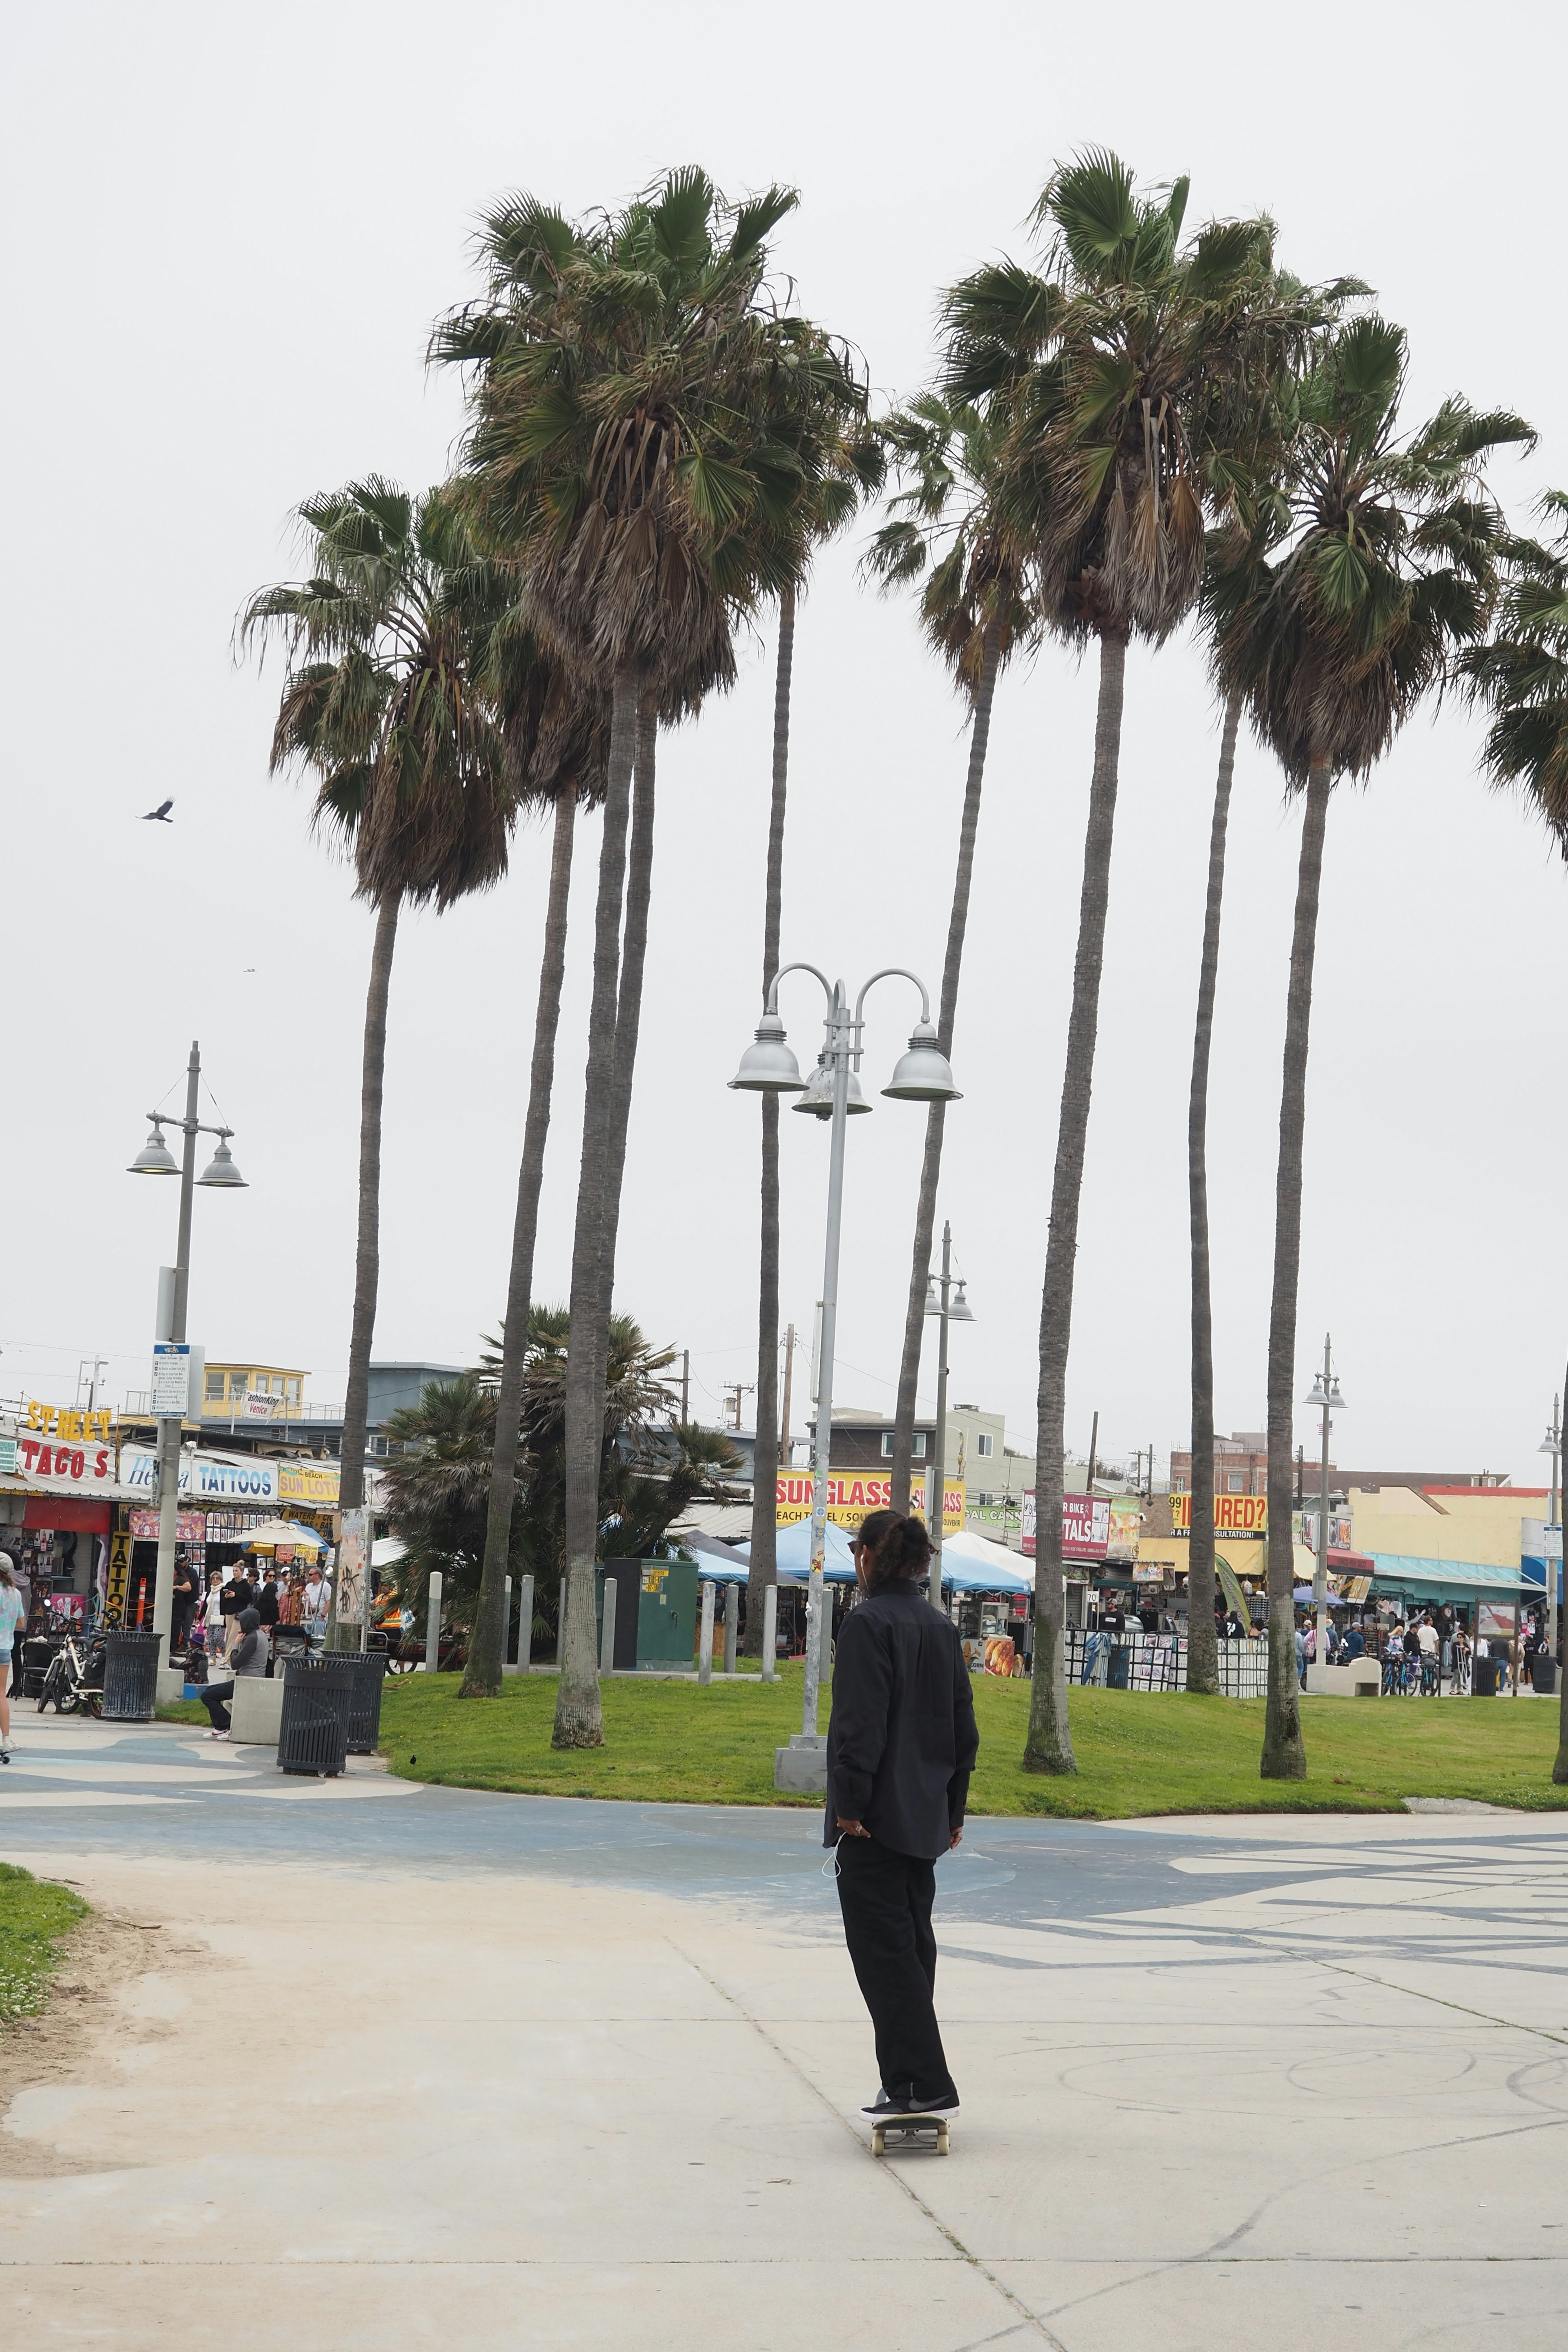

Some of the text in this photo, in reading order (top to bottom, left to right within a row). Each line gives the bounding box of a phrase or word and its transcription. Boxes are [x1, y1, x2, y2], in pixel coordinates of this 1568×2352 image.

[249, 1403, 267, 1414] Venice
[27, 1400, 112, 1441] STREET
[127, 1456, 189, 1488] Hea
[199, 1466, 272, 1496] TATTOOS
[280, 1475, 304, 1494] SUN
[288, 1510, 315, 1520] WATERS
[777, 1511, 802, 1520] EACH
[804, 1512, 837, 1521] TEL
[1069, 1502, 1084, 1514] BIKE
[1182, 1497, 1266, 1528] IURED?
[942, 1519, 960, 1527] OUVENIR
[1062, 1519, 1092, 1542] TALS
[106, 1535, 129, 1629] TATTOO
